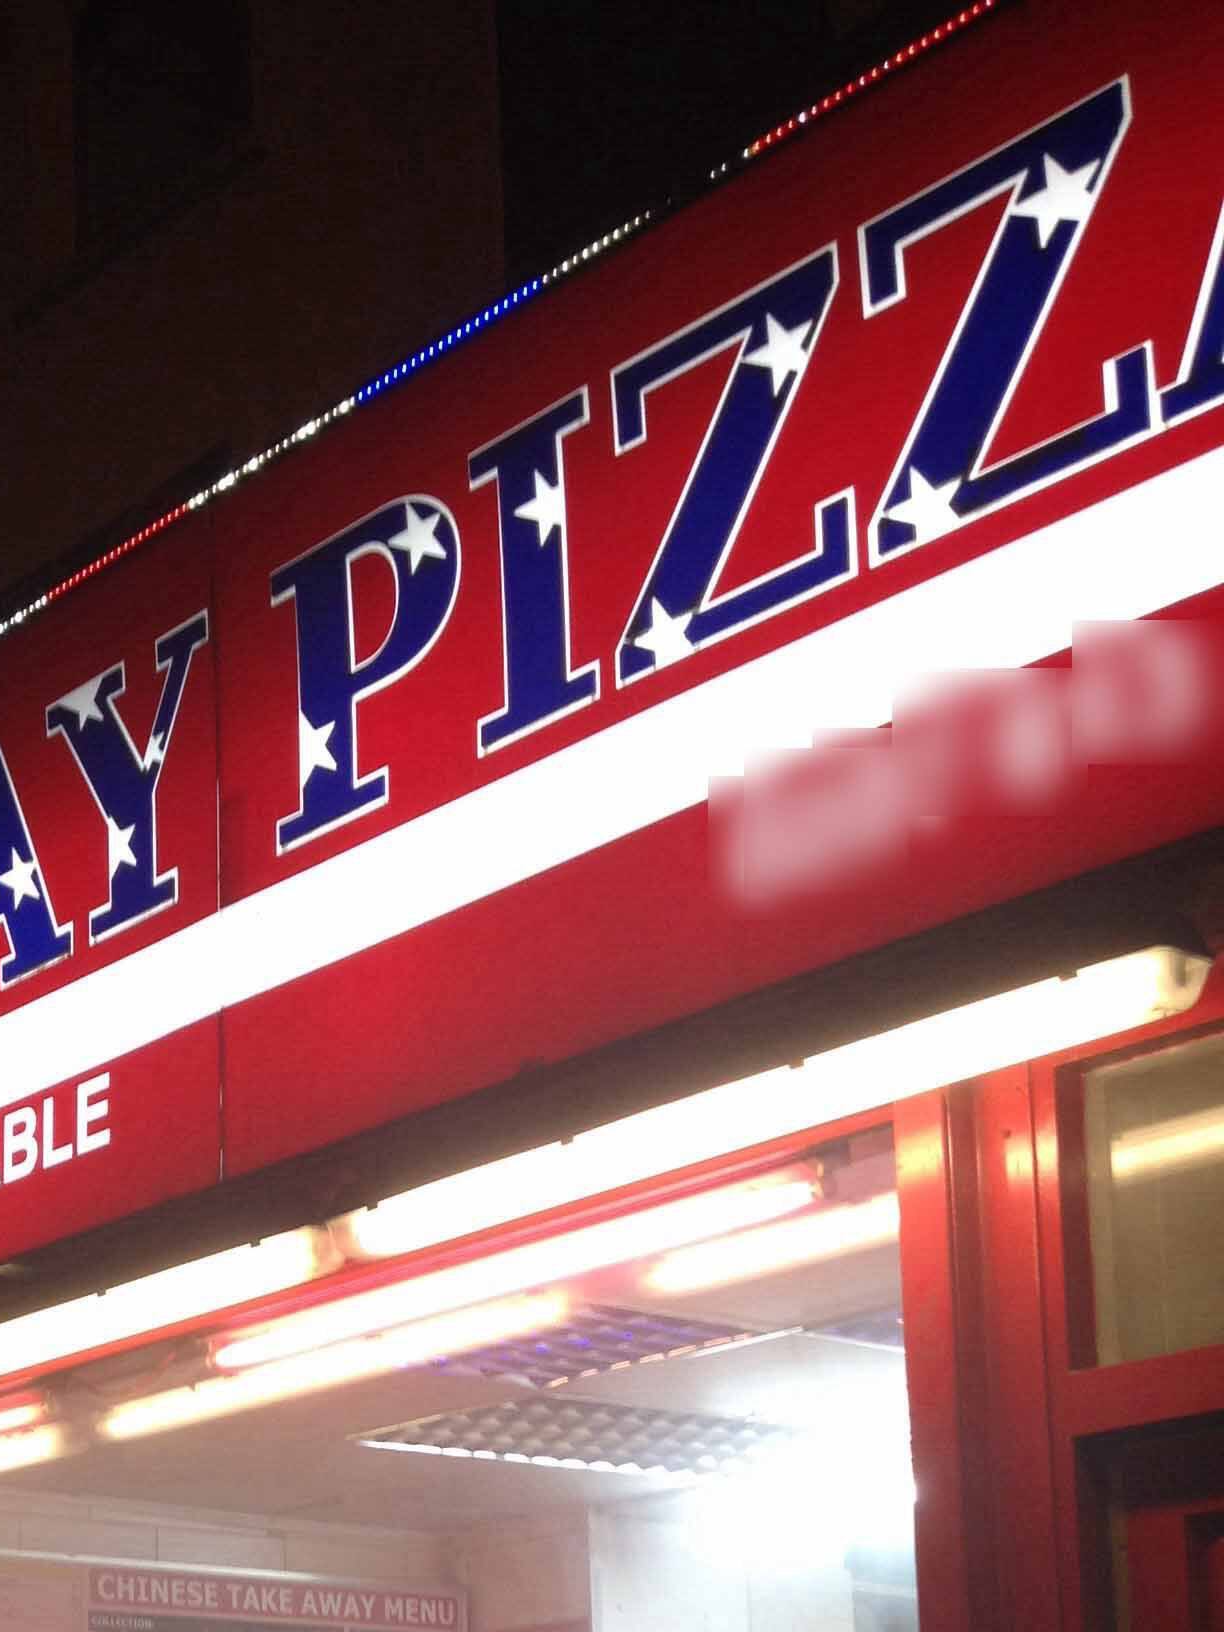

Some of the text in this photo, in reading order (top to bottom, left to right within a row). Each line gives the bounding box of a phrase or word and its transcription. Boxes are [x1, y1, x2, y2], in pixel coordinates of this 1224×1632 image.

[270, 73, 1224, 857] PIZZ
[96, 1574, 457, 1627] CHINESE TAKE AWAY MENU
